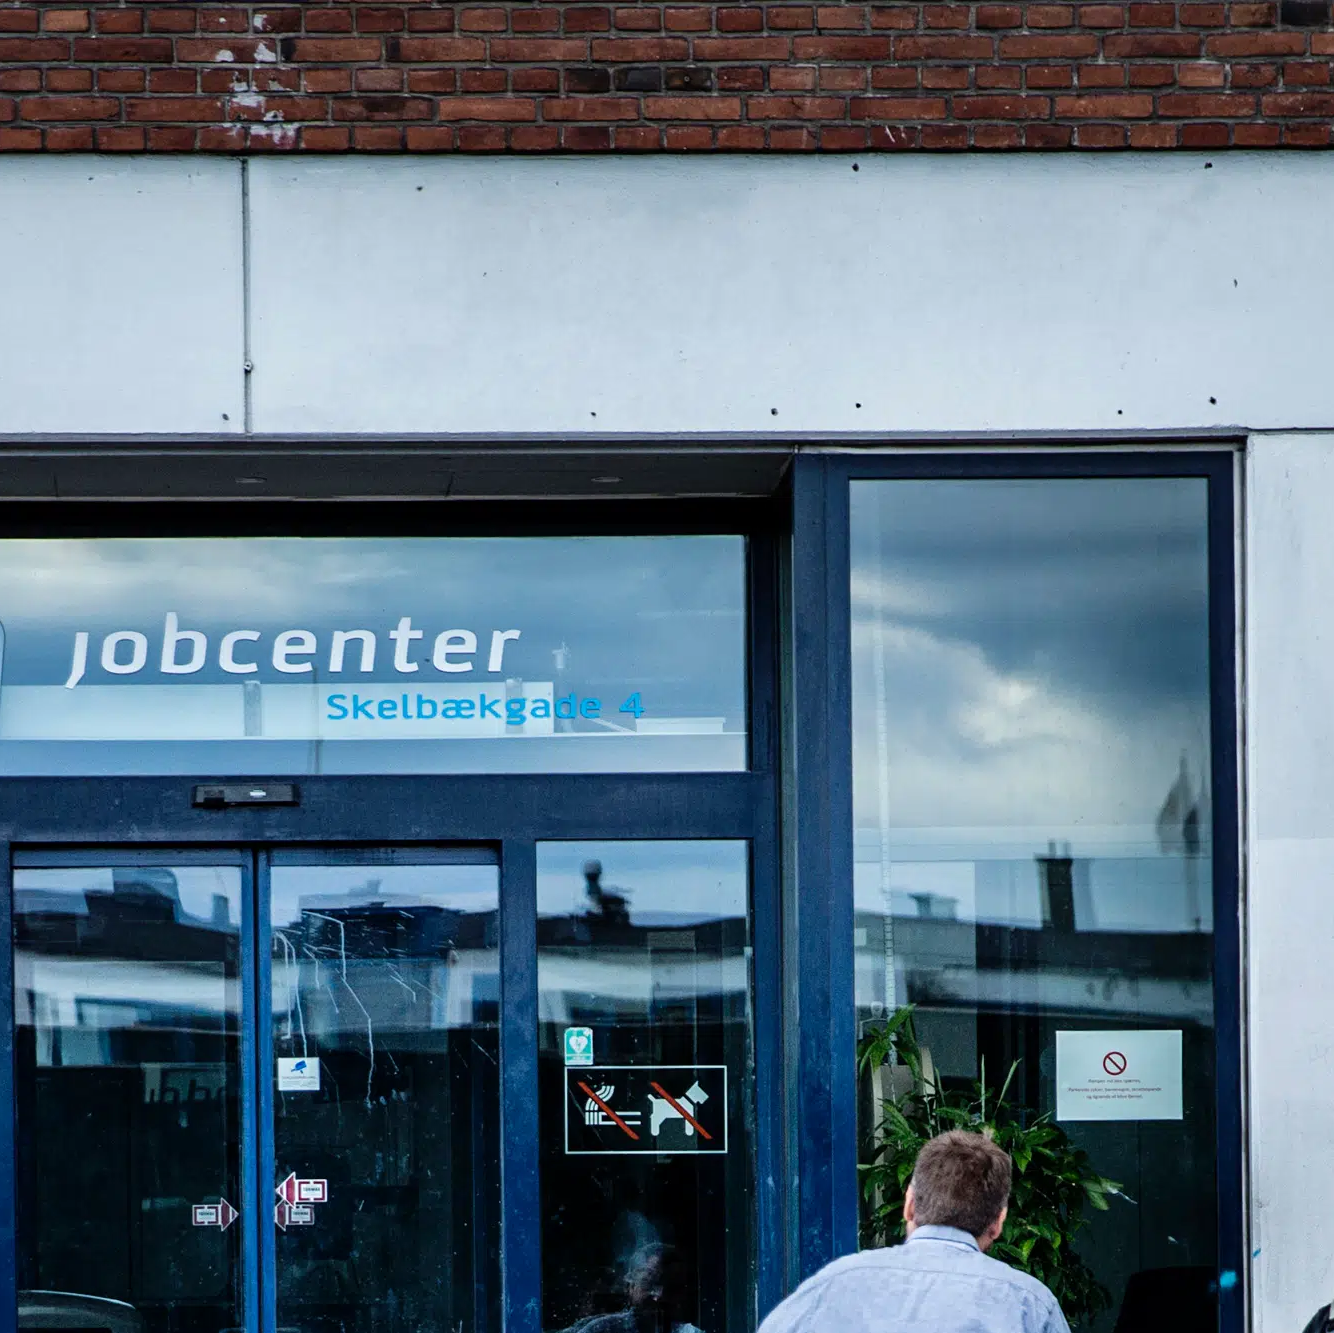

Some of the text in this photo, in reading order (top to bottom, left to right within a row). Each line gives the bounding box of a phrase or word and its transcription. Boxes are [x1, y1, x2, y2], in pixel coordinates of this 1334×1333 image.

[65, 611, 521, 689] jobcenter
[326, 692, 645, 726] Skelbækgade 4
